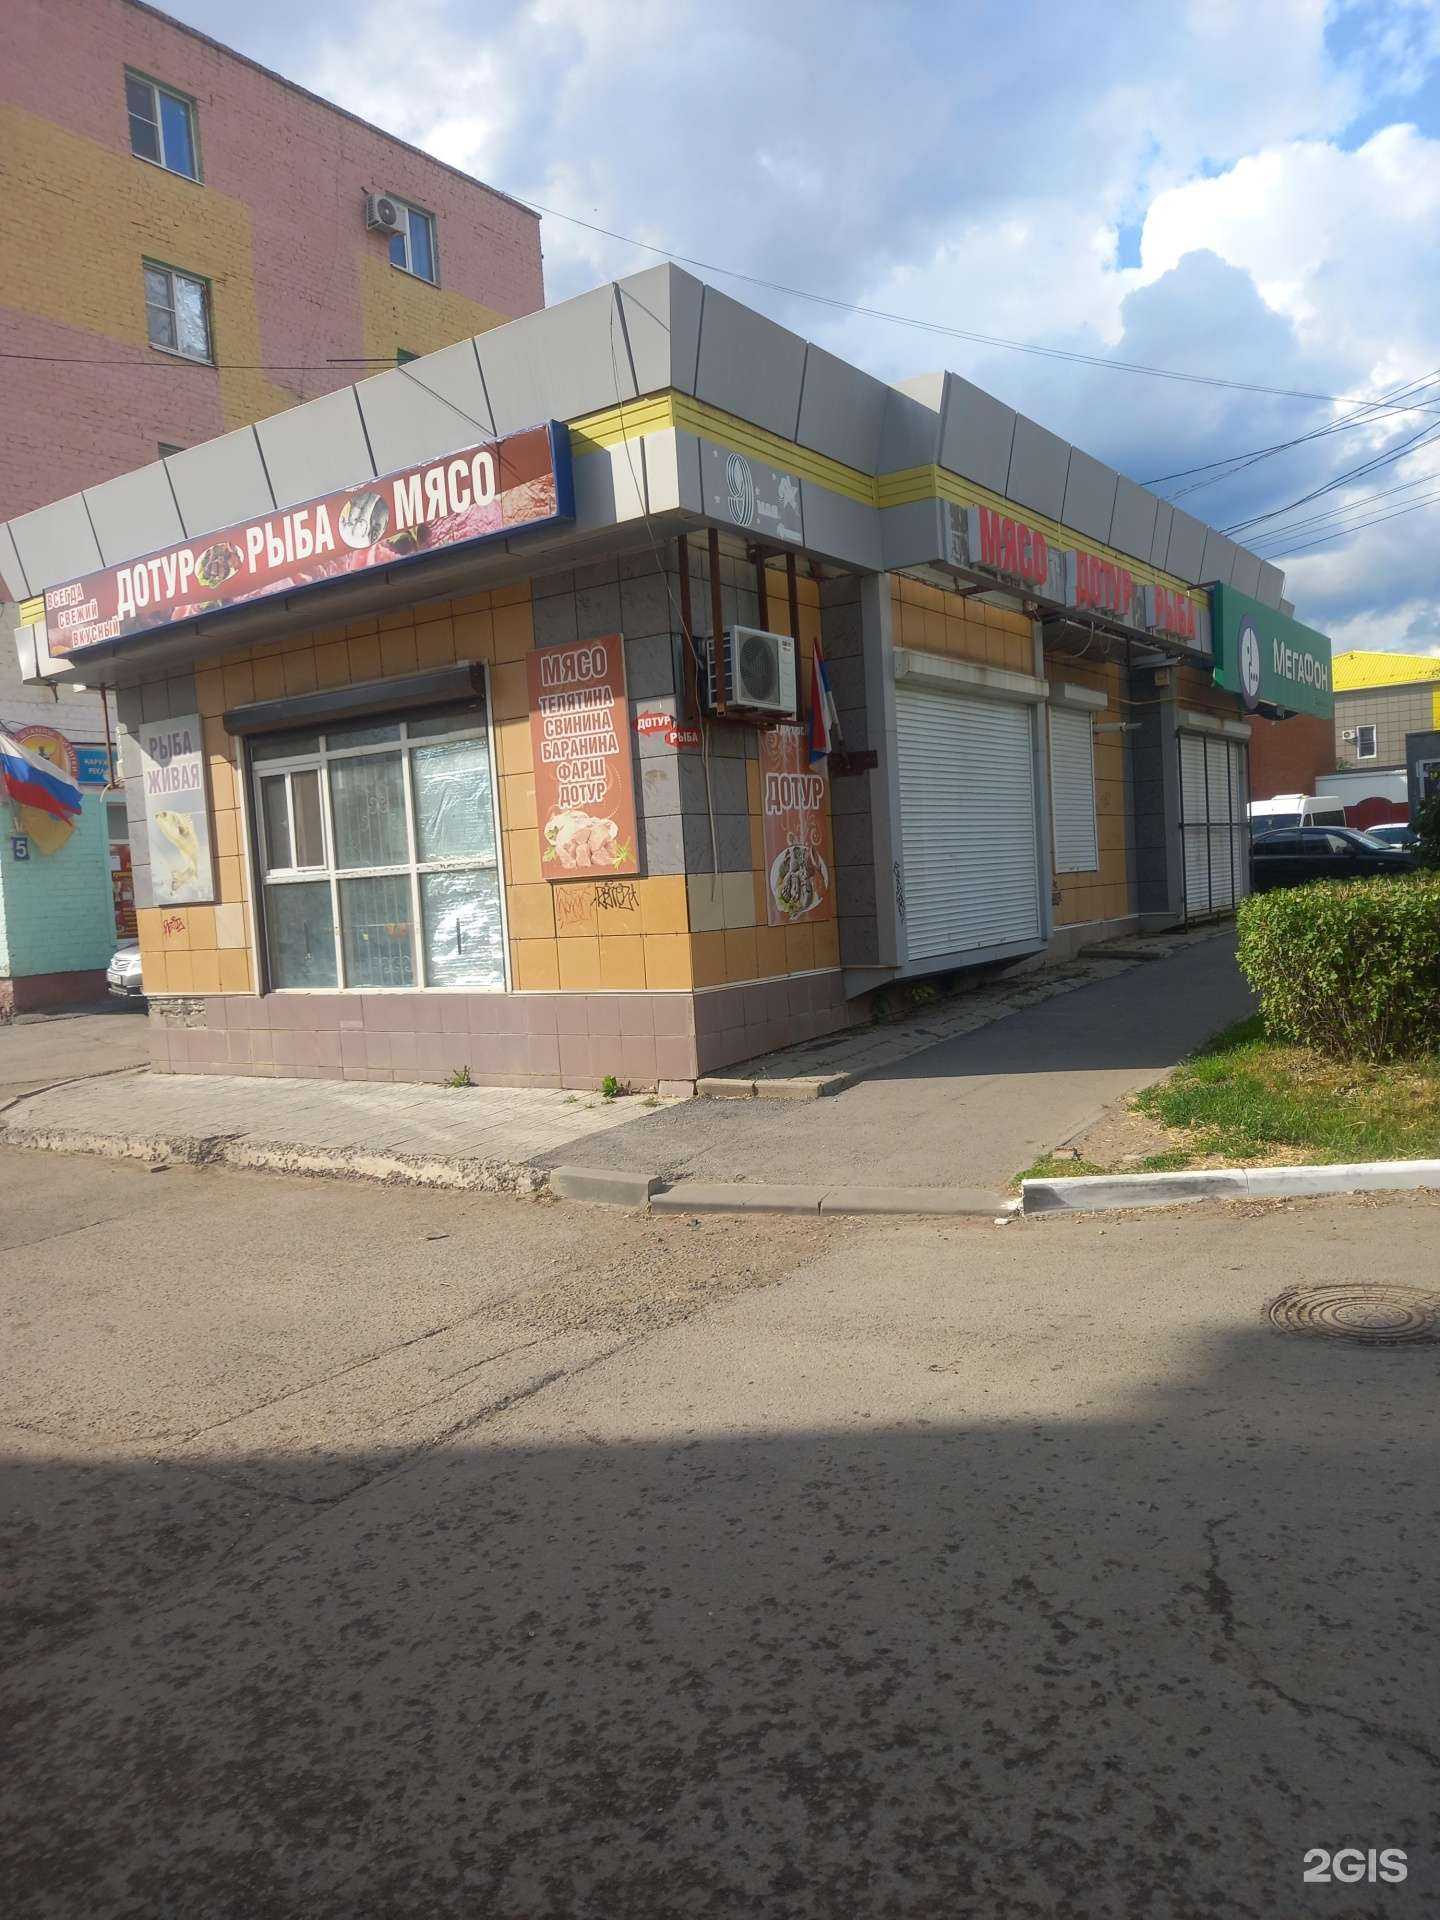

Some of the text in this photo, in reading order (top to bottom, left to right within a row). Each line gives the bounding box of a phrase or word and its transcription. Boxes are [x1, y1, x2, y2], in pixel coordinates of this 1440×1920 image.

[116, 451, 496, 620] ДОТУР РЫБА МЯСО
[979, 505, 1048, 586] МЯСО
[1154, 584, 1196, 640] РЫБА
[46, 583, 84, 611] ВСЕГДА
[57, 598, 99, 629] СВЕЖИЙ
[72, 615, 121, 648] ВКУСНЫЙ
[541, 646, 607, 687] МЯСО
[539, 686, 614, 717] ТЕЛЯТИНА
[544, 709, 613, 740] СВИНИНА
[637, 715, 671, 731] ДОТУР
[669, 731, 698, 744] РЫБА
[151, 730, 193, 757] РЫБА
[542, 732, 619, 762] БАРАНИНА
[148, 763, 201, 794] ЖИВАЯ
[557, 757, 606, 784] ФАРШ
[559, 780, 606, 809] ДОТУР
[765, 772, 824, 816] ДОТУР
[15, 840, 27, 858] 5
